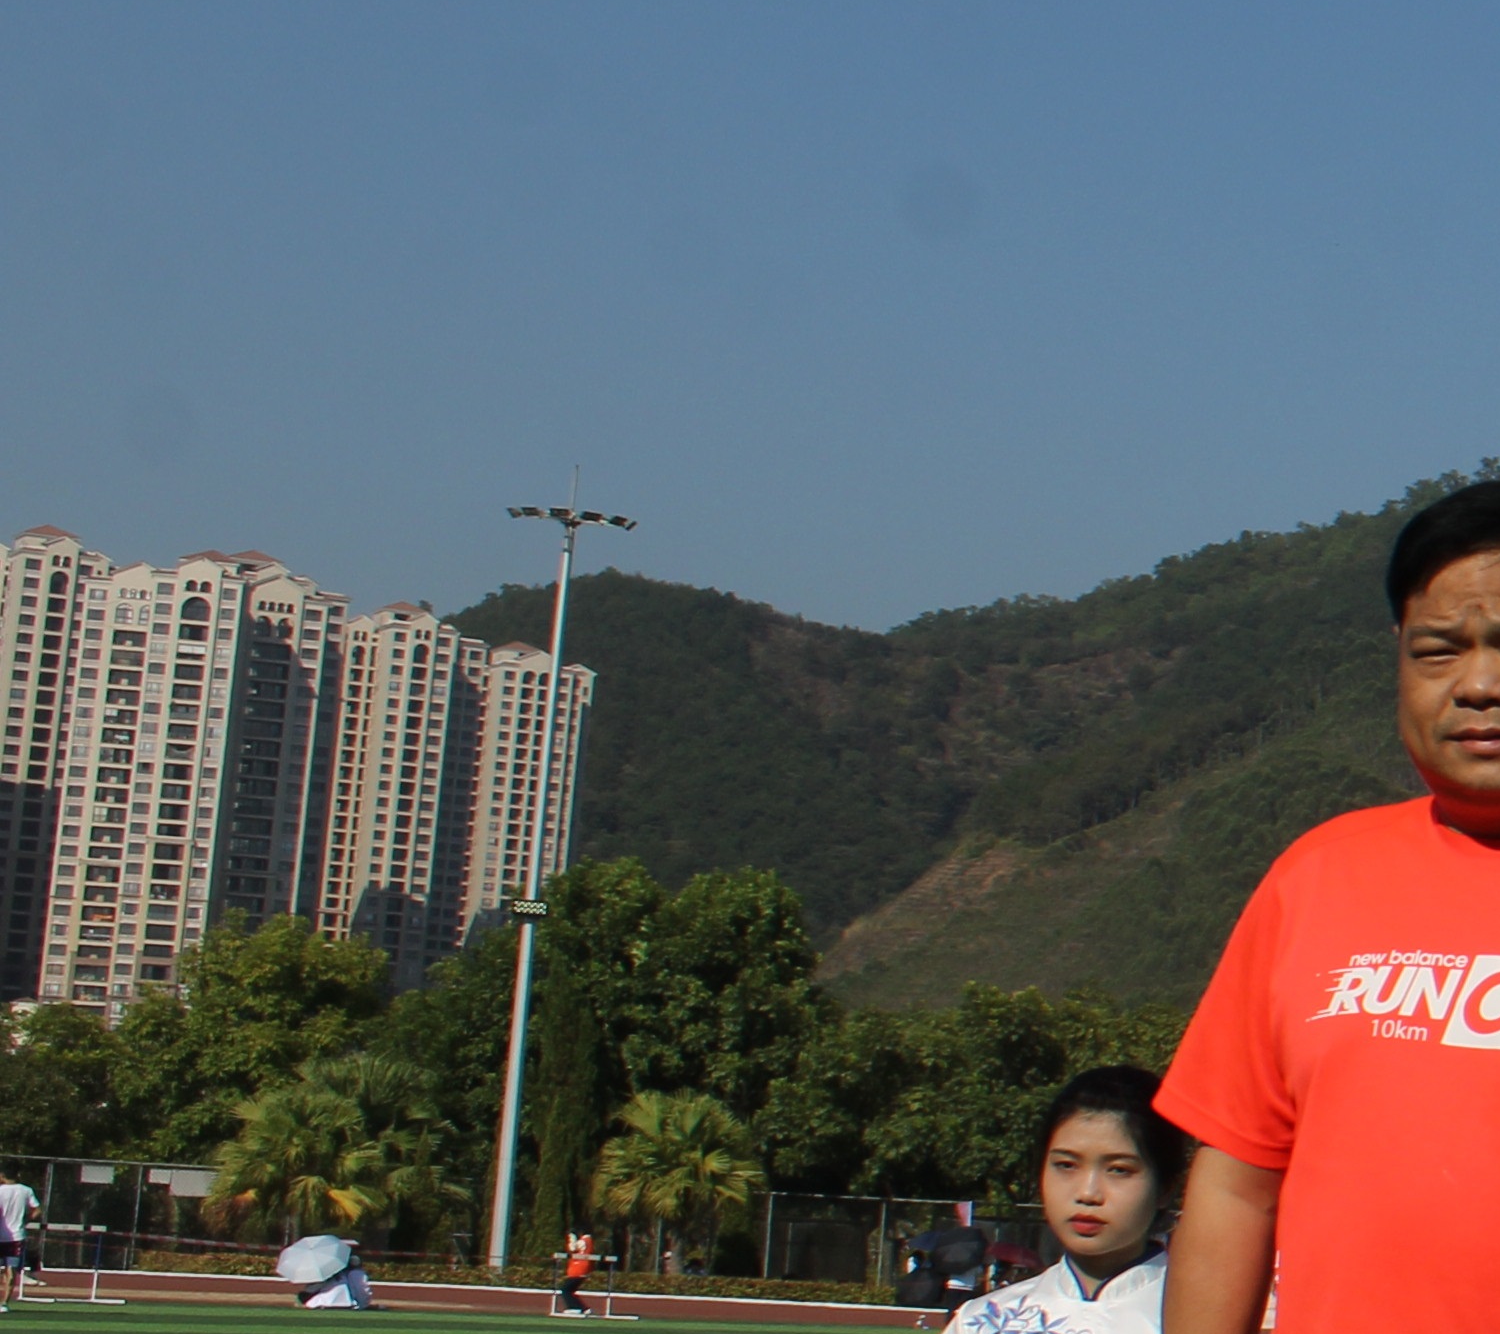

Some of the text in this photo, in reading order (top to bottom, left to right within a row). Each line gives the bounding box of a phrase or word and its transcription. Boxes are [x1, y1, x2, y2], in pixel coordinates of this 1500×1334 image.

[1350, 950, 1468, 968] new balance
[1320, 966, 1464, 1020] RUN
[1370, 1019, 1428, 1042] 10km
